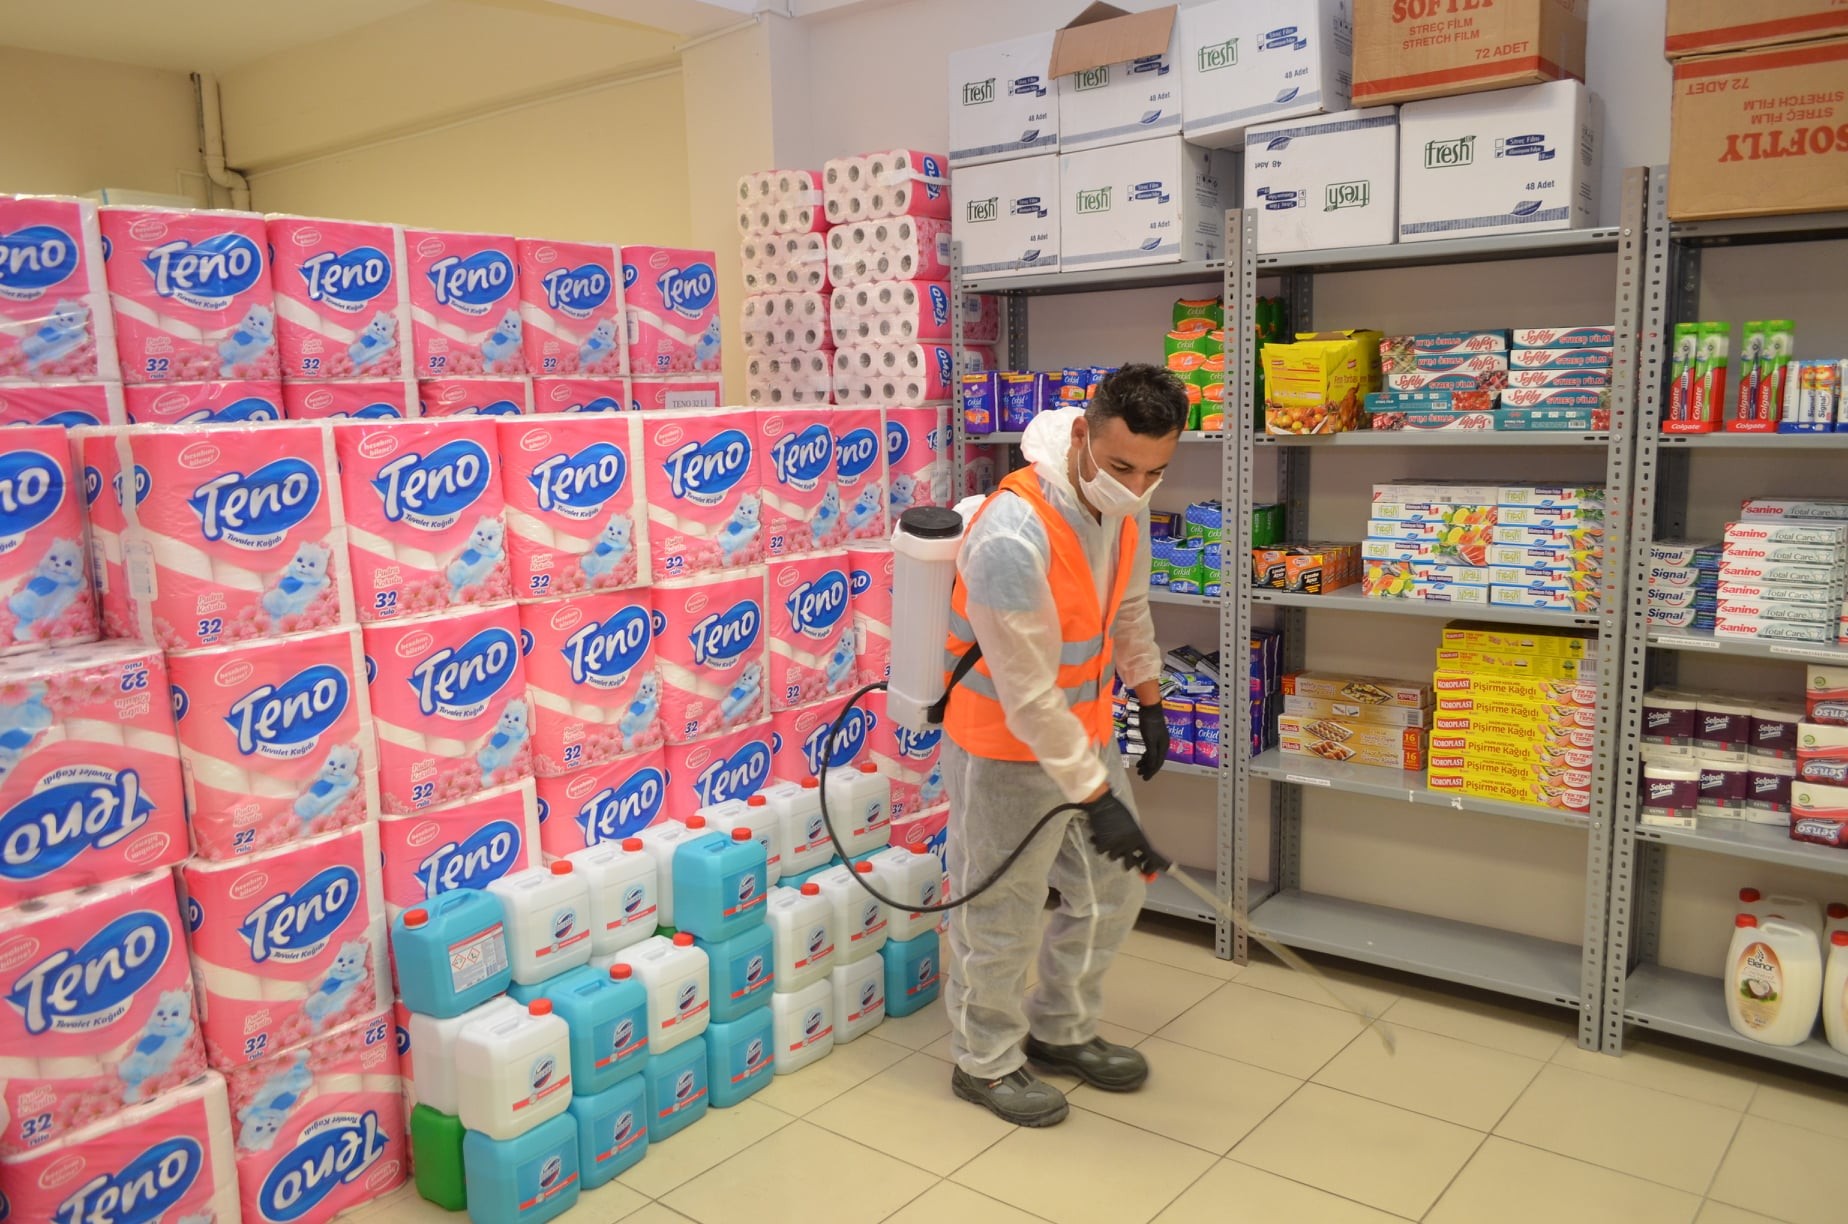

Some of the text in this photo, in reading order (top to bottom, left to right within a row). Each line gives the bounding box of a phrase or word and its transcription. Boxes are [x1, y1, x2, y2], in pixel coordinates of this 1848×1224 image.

[1409, 17, 1473, 37] STREÇ FİLM
[1402, 29, 1480, 50] STRETCH FILM
[1199, 43, 1235, 70] fresh
[1475, 41, 1529, 60] 72 ADET
[1075, 67, 1108, 91] fresh
[1294, 67, 1308, 77] Adet
[964, 81, 994, 104] fresh
[1685, 77, 1749, 96] 72 ADET
[1158, 92, 1170, 100] Adet
[1743, 90, 1844, 111] STRETCH FILM
[1036, 113, 1047, 121] Adet
[1427, 141, 1470, 166] fresh
[1526, 180, 1555, 191] 48 Adet
[1077, 190, 1109, 213] fresh
[1329, 184, 1368, 208] fresh
[968, 202, 997, 222] fresh
[1158, 220, 1170, 228] Adet
[149, 244, 251, 296] Teno
[303, 255, 383, 299] Teno
[431, 258, 506, 302] Teno
[544, 269, 605, 307] Teno
[660, 270, 711, 308] Teno
[931, 286, 947, 327] Teno
[1521, 329, 1555, 345] Softly
[146, 358, 168, 372] 32
[302, 358, 320, 370] 32
[429, 356, 446, 368] 32
[543, 358, 556, 368] 32
[657, 355, 670, 366] 32
[1517, 350, 1552, 365] Softly
[1395, 375, 1424, 390] Softly
[1514, 371, 1549, 386] Softly
[1507, 389, 1543, 406] Softly
[1671, 387, 1679, 420] Colgate
[1693, 387, 1702, 420] Colgate
[1740, 386, 1748, 418] Colgate
[1760, 386, 1769, 419] Colgate
[1818, 392, 1827, 418] Signal
[774, 435, 827, 482] Teno
[666, 441, 743, 496] Teno
[378, 455, 480, 518] Teno
[533, 455, 618, 508] Teno
[195, 473, 308, 538] Teno
[1746, 506, 1783, 514] sanino
[1729, 530, 1767, 538] sanino
[770, 537, 783, 548] 32
[1650, 549, 1682, 560] Signal
[1728, 549, 1765, 557] sanino
[665, 557, 682, 569] 32
[1652, 569, 1687, 579] Signal
[1724, 568, 1761, 577] sanino
[530, 575, 549, 588] 32
[1648, 590, 1682, 600] Signal
[1722, 587, 1760, 595] sanino
[375, 592, 397, 608] 32
[790, 582, 843, 630] Teno
[1648, 609, 1683, 620] Signal
[1721, 606, 1759, 614] sanino
[198, 618, 222, 636] 32
[1719, 625, 1757, 633] sanino
[692, 616, 754, 663] Teno
[565, 618, 644, 678] Teno
[121, 671, 148, 690] 32
[413, 641, 507, 711] Teno
[787, 686, 799, 698] 32
[1437, 680, 1470, 689] KOROPLAST
[1474, 683, 1536, 696] Pişirme Kağıdı
[1441, 700, 1473, 710] KOROPLAST
[1477, 704, 1538, 717] Pişirme Kağıdı
[231, 679, 337, 751] Teno
[1649, 712, 1672, 720] Selpak
[1705, 716, 1729, 726] Selpak
[685, 722, 697, 734] 32
[1438, 720, 1470, 729] KOROPLAST
[1473, 723, 1535, 737] Pişirme Kağıdı
[1759, 724, 1783, 734] Selpak
[1404, 734, 1415, 742] 16
[1434, 739, 1465, 748] KOROPLAST
[564, 745, 581, 761] 32
[803, 722, 860, 773] Teno
[1469, 743, 1530, 757] Pişirme Kağıdı
[1406, 753, 1416, 761] 16
[1432, 758, 1464, 767] KOROPLAST
[1467, 762, 1529, 776] Pişirme Kağıdı
[697, 757, 766, 807] Teno
[1431, 777, 1463, 787] KOROPLAST
[1701, 774, 1724, 784] Selpak
[1754, 777, 1779, 787] Selpak
[412, 783, 433, 800] 32
[1466, 781, 1527, 796] Pişirme Kağıdı
[1651, 783, 1674, 793] Selpak
[4, 771, 148, 863] Teno
[580, 783, 657, 846] Teno
[234, 830, 255, 846] 32
[421, 832, 510, 898] Teno
[246, 879, 348, 959] Teno
[1748, 958, 1774, 970] Elenor
[15, 927, 155, 1032] Teno
[366, 1025, 387, 1044] 32
[245, 1034, 267, 1055] 32
[21, 1115, 53, 1139] 32
[272, 1114, 384, 1209] Teno
[59, 1151, 188, 1224] Teno
